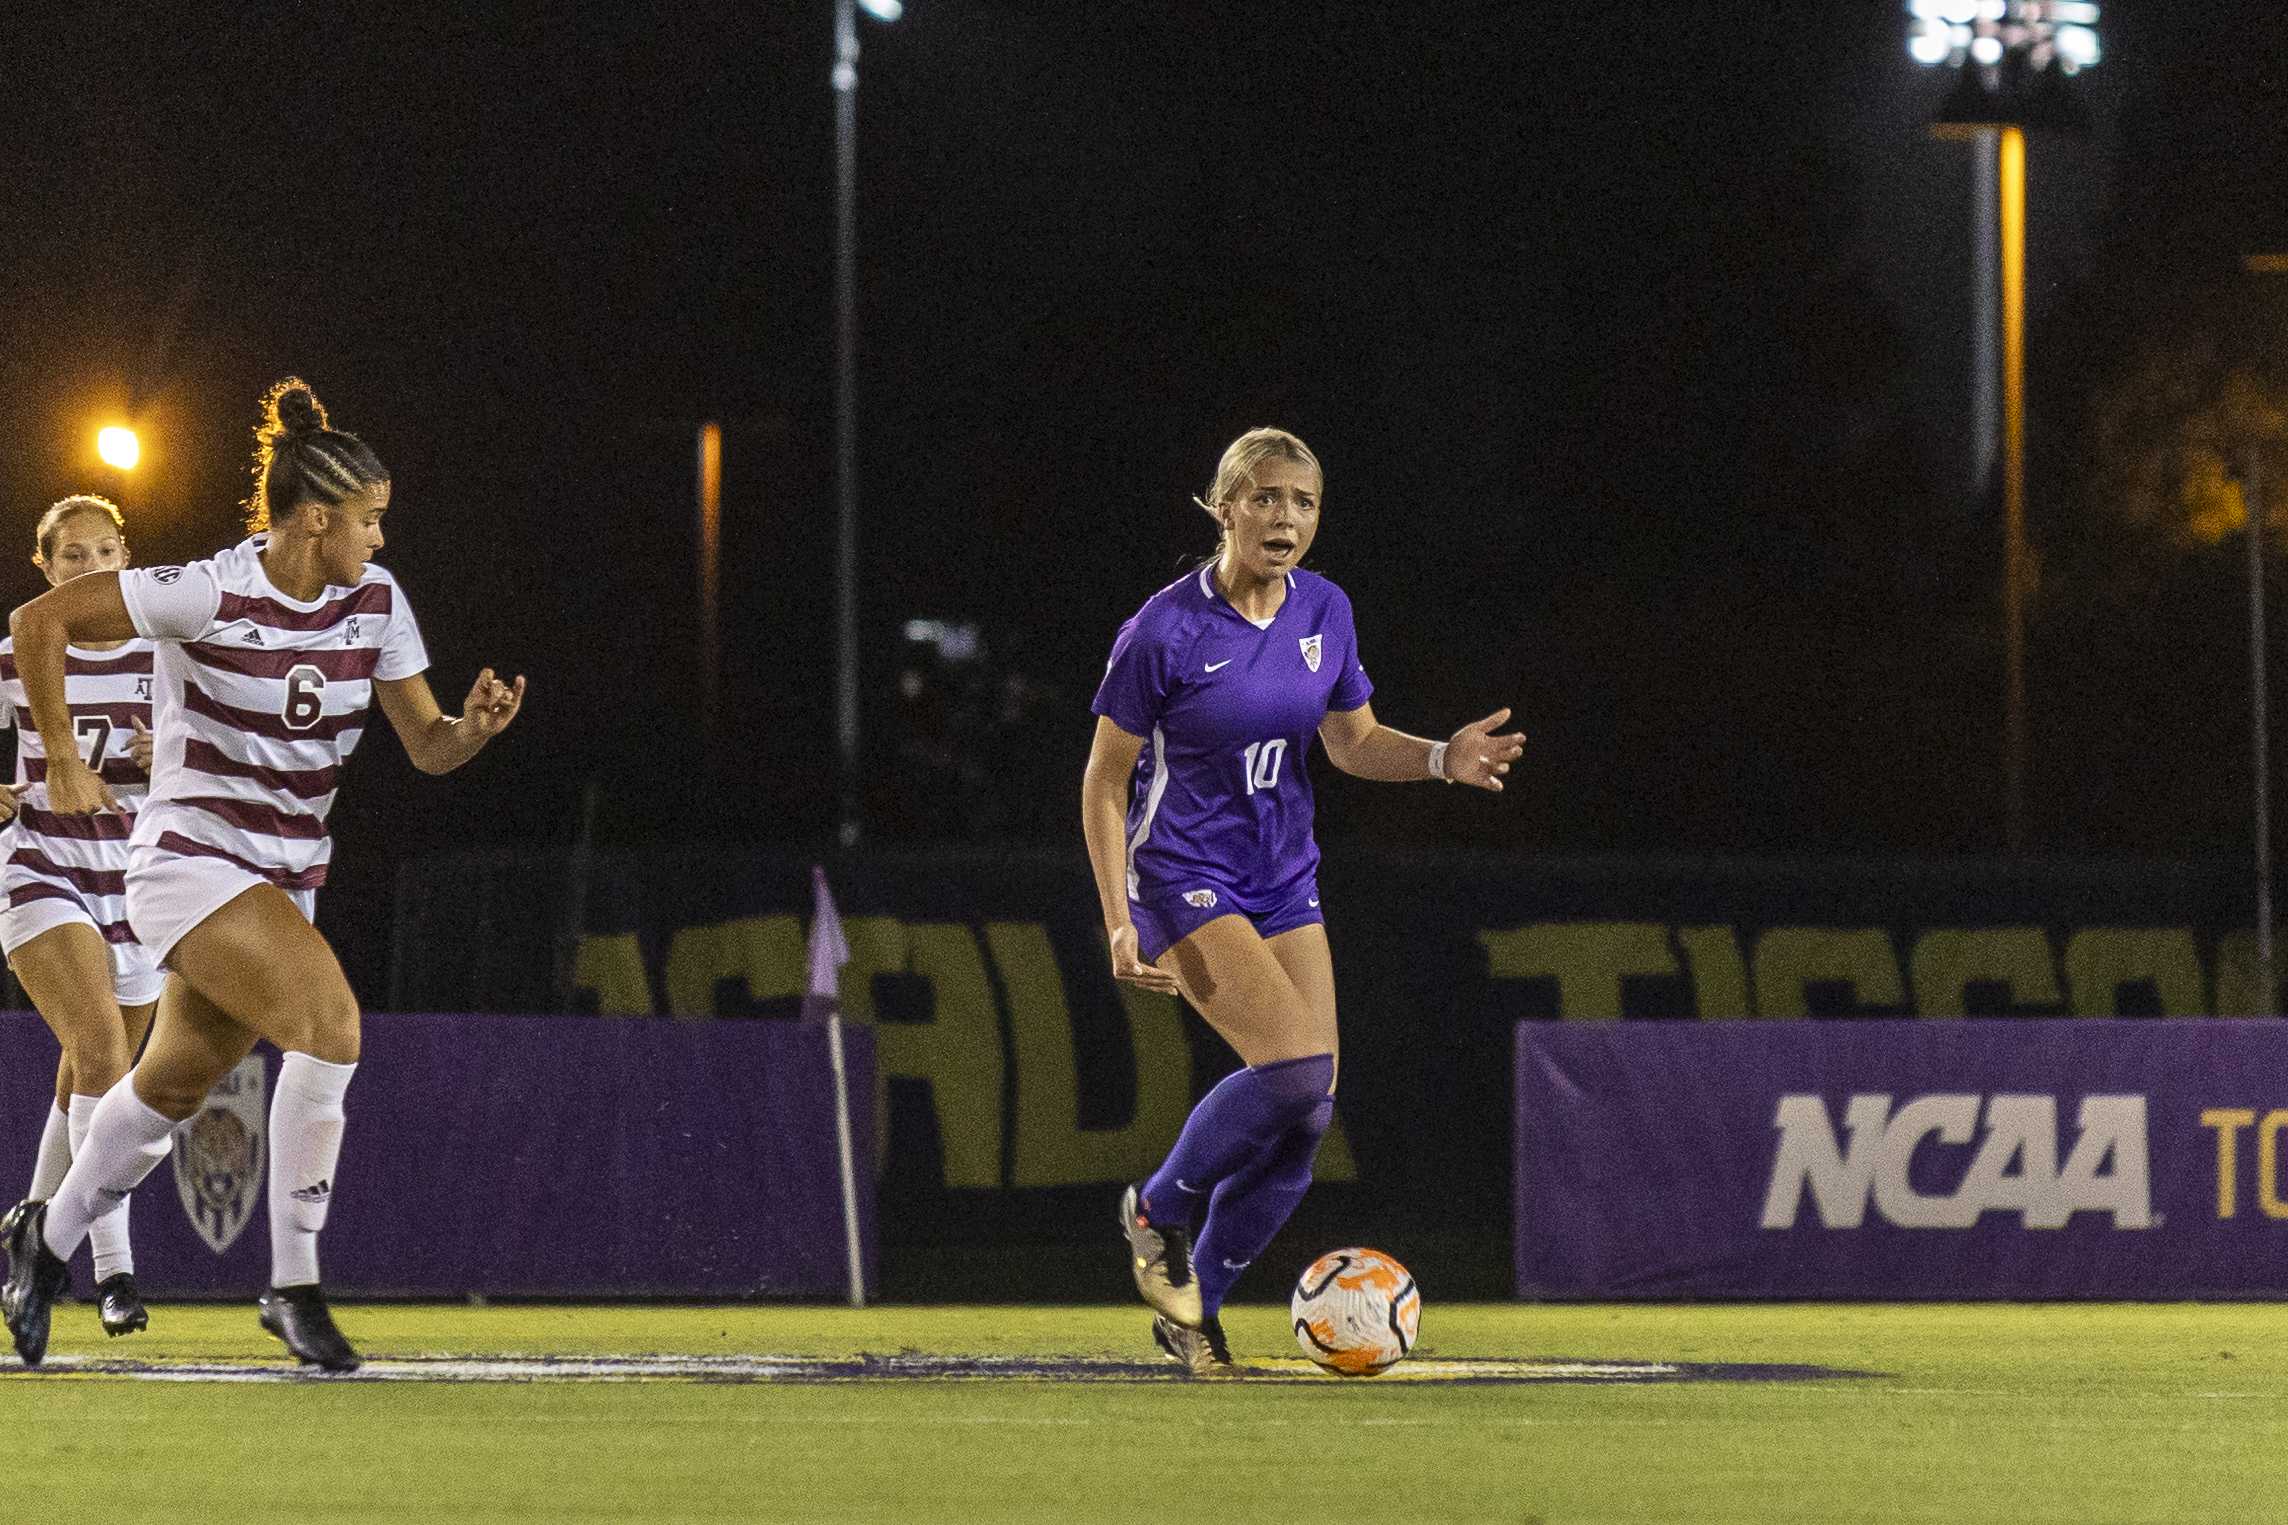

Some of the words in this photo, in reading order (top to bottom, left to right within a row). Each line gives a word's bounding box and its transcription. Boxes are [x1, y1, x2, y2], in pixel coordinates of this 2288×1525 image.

[282, 665, 326, 730] 6
[74, 715, 111, 773] 7
[1244, 739, 1288, 795] 10
[1761, 1095, 2150, 1230] NCAA
